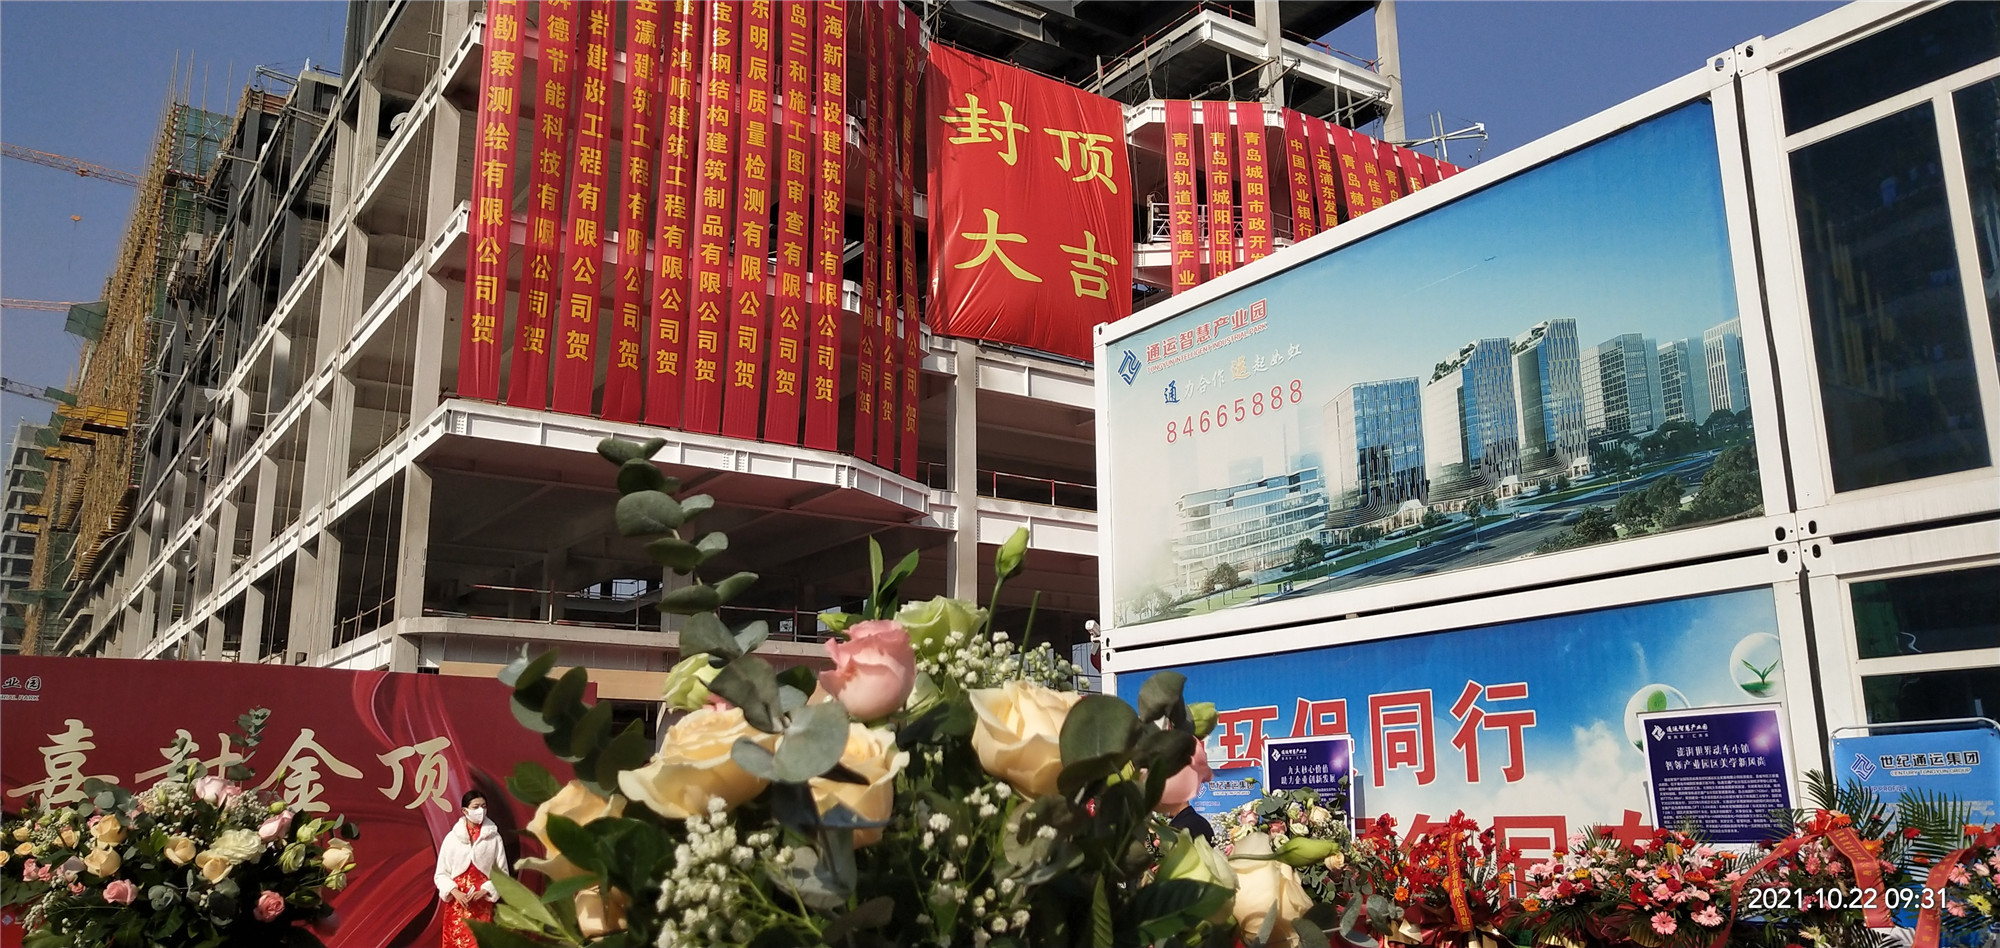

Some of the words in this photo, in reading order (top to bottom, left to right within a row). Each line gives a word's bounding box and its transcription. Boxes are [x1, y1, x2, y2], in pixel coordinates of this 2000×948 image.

[939, 93, 1118, 194] 封顶
[565, 1, 610, 362] 岩建设工程有限公司贺
[1172, 132, 1196, 289] 青岛轨道交通产业
[1290, 138, 1313, 238] 中国农业银行
[1316, 146, 1339, 228] 上海浦东发展
[954, 208, 1119, 300] 大吉
[1146, 298, 1268, 364] 通运智慧产业园
[1249, 323, 1267, 335] PARK
[1166, 379, 1303, 444] 84665888
[1281, 773, 1336, 785] 助力企业创新发展
[1676, 743, 1751, 757] 澎湃世界动车小镇
[1880, 751, 1981, 769] 世纪通运集团
